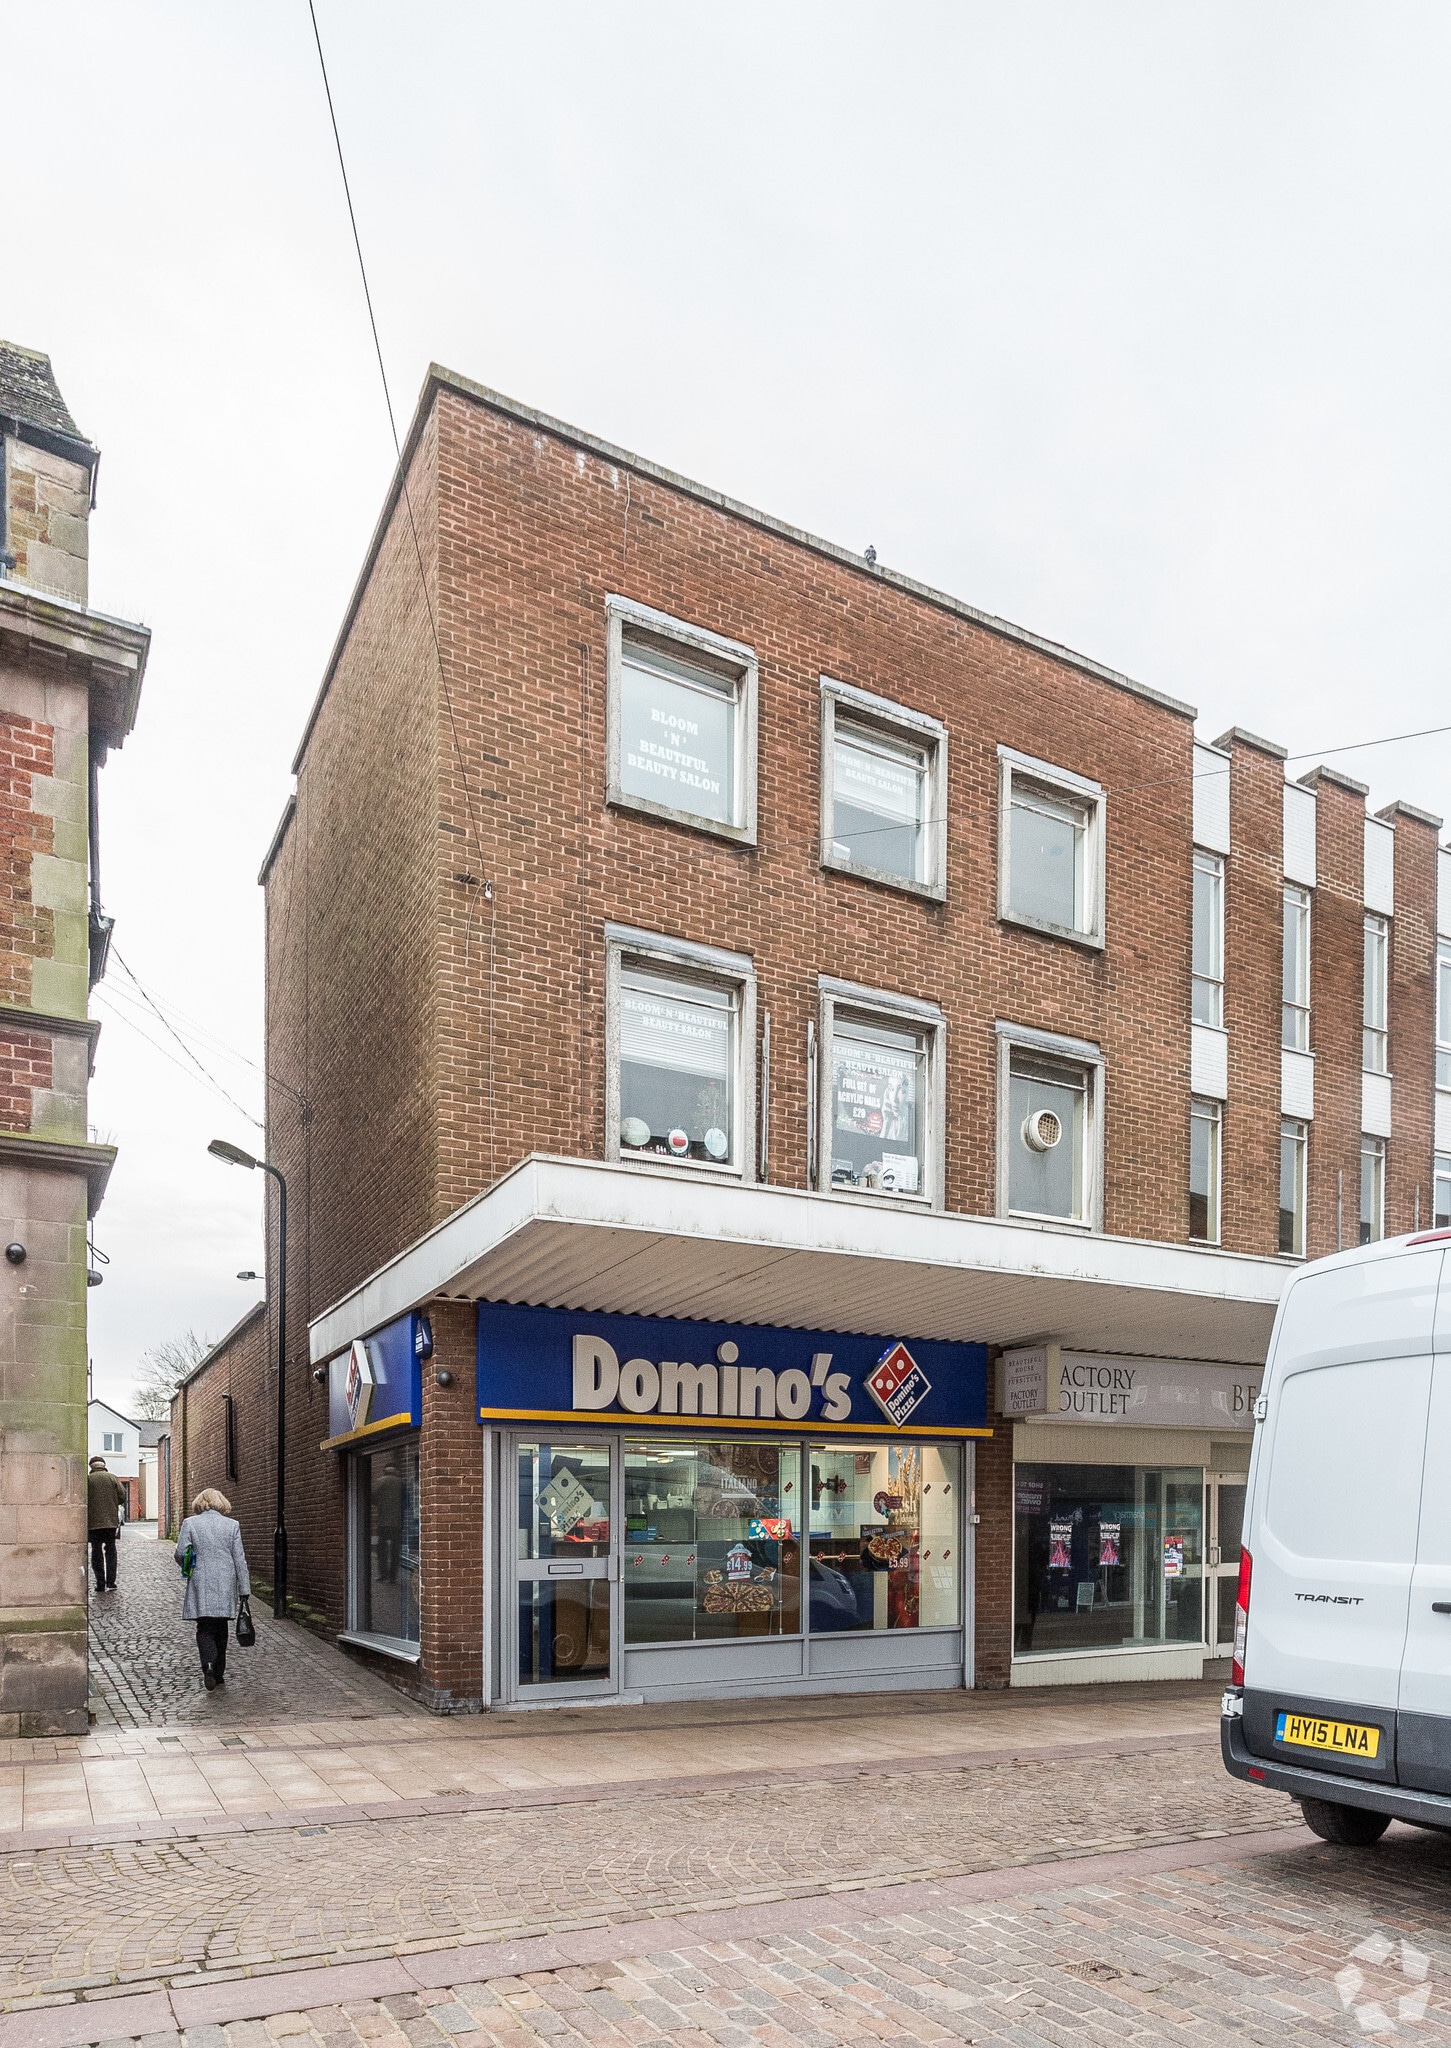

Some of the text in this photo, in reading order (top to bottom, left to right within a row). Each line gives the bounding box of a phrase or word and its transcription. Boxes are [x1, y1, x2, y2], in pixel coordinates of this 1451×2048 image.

[651, 708, 698, 736] BLOOM
[639, 739, 709, 774] BEAUTIFUL
[627, 752, 720, 794] BEAUTY SALON
[845, 767, 877, 785] BEAUTY
[642, 1016, 712, 1039] BEAUTY SALON
[845, 1060, 876, 1075] BEAUTY
[877, 1067, 904, 1079] SALON
[842, 1077, 877, 1094] FULL SET OF
[837, 1091, 881, 1108] ACRYLIC NAILS
[852, 1107, 866, 1119] £20
[573, 1334, 852, 1421] Domino's
[1015, 1365, 1034, 1373] HOUSE
[1060, 1365, 1136, 1390] ACTORY
[887, 1373, 920, 1412] Domino's
[1010, 1388, 1038, 1401] FACTORY
[1232, 1384, 1257, 1412] BE
[894, 1395, 916, 1421] Pizza
[1012, 1398, 1036, 1410] OUTLET
[721, 1478, 758, 1490] ITALIANO
[1050, 1524, 1072, 1533] WRONG
[1100, 1523, 1120, 1531] WRONG
[726, 1557, 753, 1571] £14.99
[888, 1558, 909, 1569] £5.99
[1295, 1593, 1364, 1605] TRANSIT
[1290, 1717, 1369, 1751] HY15 LNA
